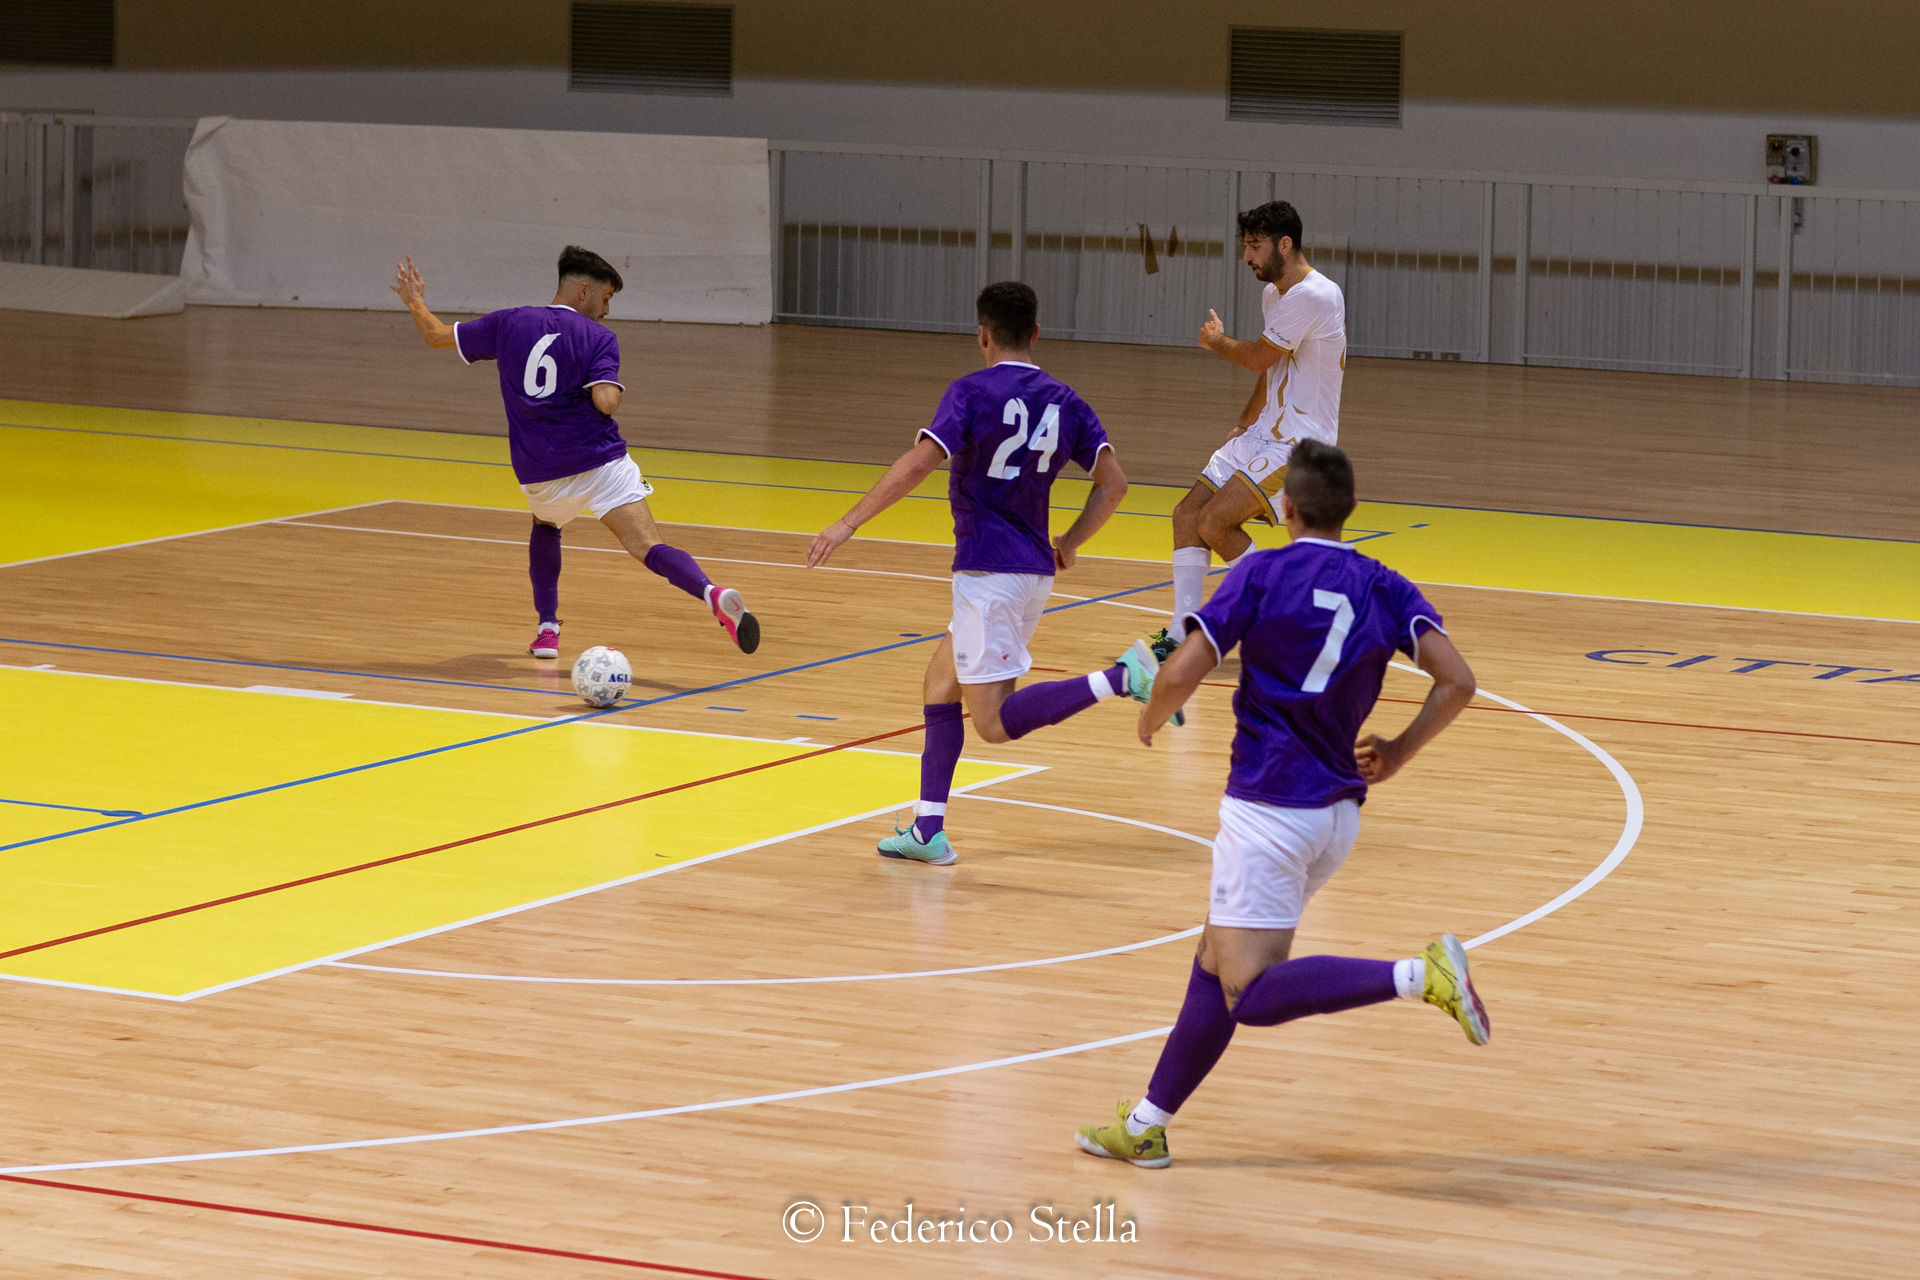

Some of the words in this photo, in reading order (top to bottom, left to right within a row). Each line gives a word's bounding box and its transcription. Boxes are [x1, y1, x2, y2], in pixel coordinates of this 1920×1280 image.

[523, 332, 562, 399] 6
[986, 397, 1061, 480] 24
[1300, 588, 1356, 693] 7
